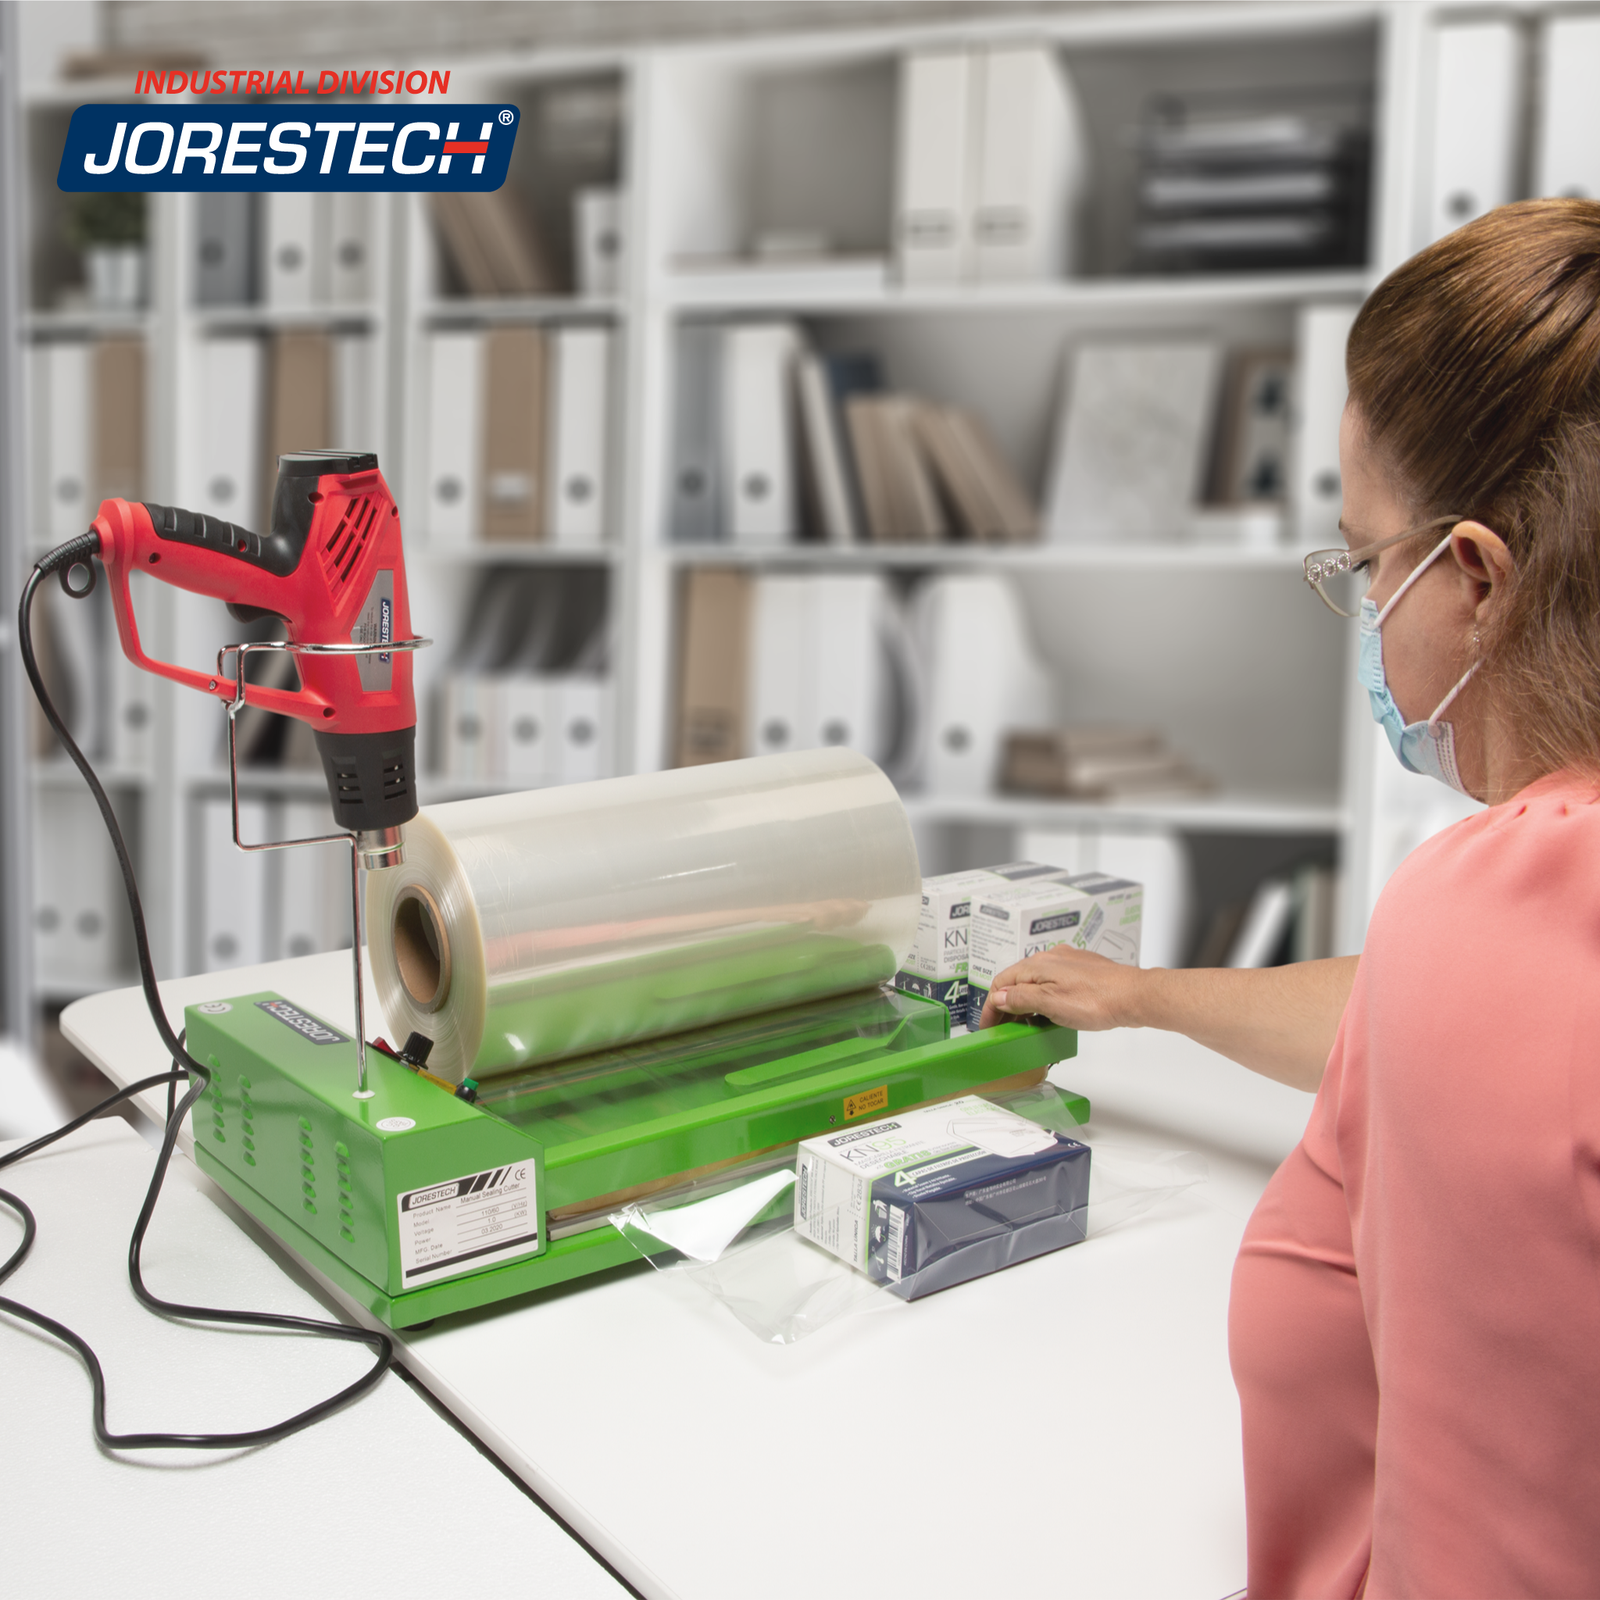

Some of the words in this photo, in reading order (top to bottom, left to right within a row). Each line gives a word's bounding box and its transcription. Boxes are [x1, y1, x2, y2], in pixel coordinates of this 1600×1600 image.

[1032, 915, 1078, 932] JORESTECH
[972, 964, 982, 973] ONE
[982, 967, 992, 976] SIZE
[944, 980, 960, 1004] 4
[262, 1001, 340, 1042] JORESTECH
[860, 1090, 883, 1103] CALIENTE
[868, 1098, 884, 1107] TOCAR
[833, 1122, 898, 1146] JORESTECH
[840, 1136, 907, 1162] KN95
[884, 1150, 932, 1169] GRATIS
[894, 1170, 917, 1188] 4
[412, 1186, 457, 1205] JORESTECH
[413, 1209, 434, 1219] Product
[461, 1193, 480, 1204] Manual
[482, 1188, 502, 1199] Sealing
[504, 1182, 520, 1192] Cutter
[414, 1227, 434, 1237] Voltage
[482, 1207, 500, 1216] 110/60
[414, 1219, 430, 1227] Model
[414, 1237, 431, 1245] Power
[416, 1255, 431, 1264] Serial
[432, 1249, 452, 1259] Number
